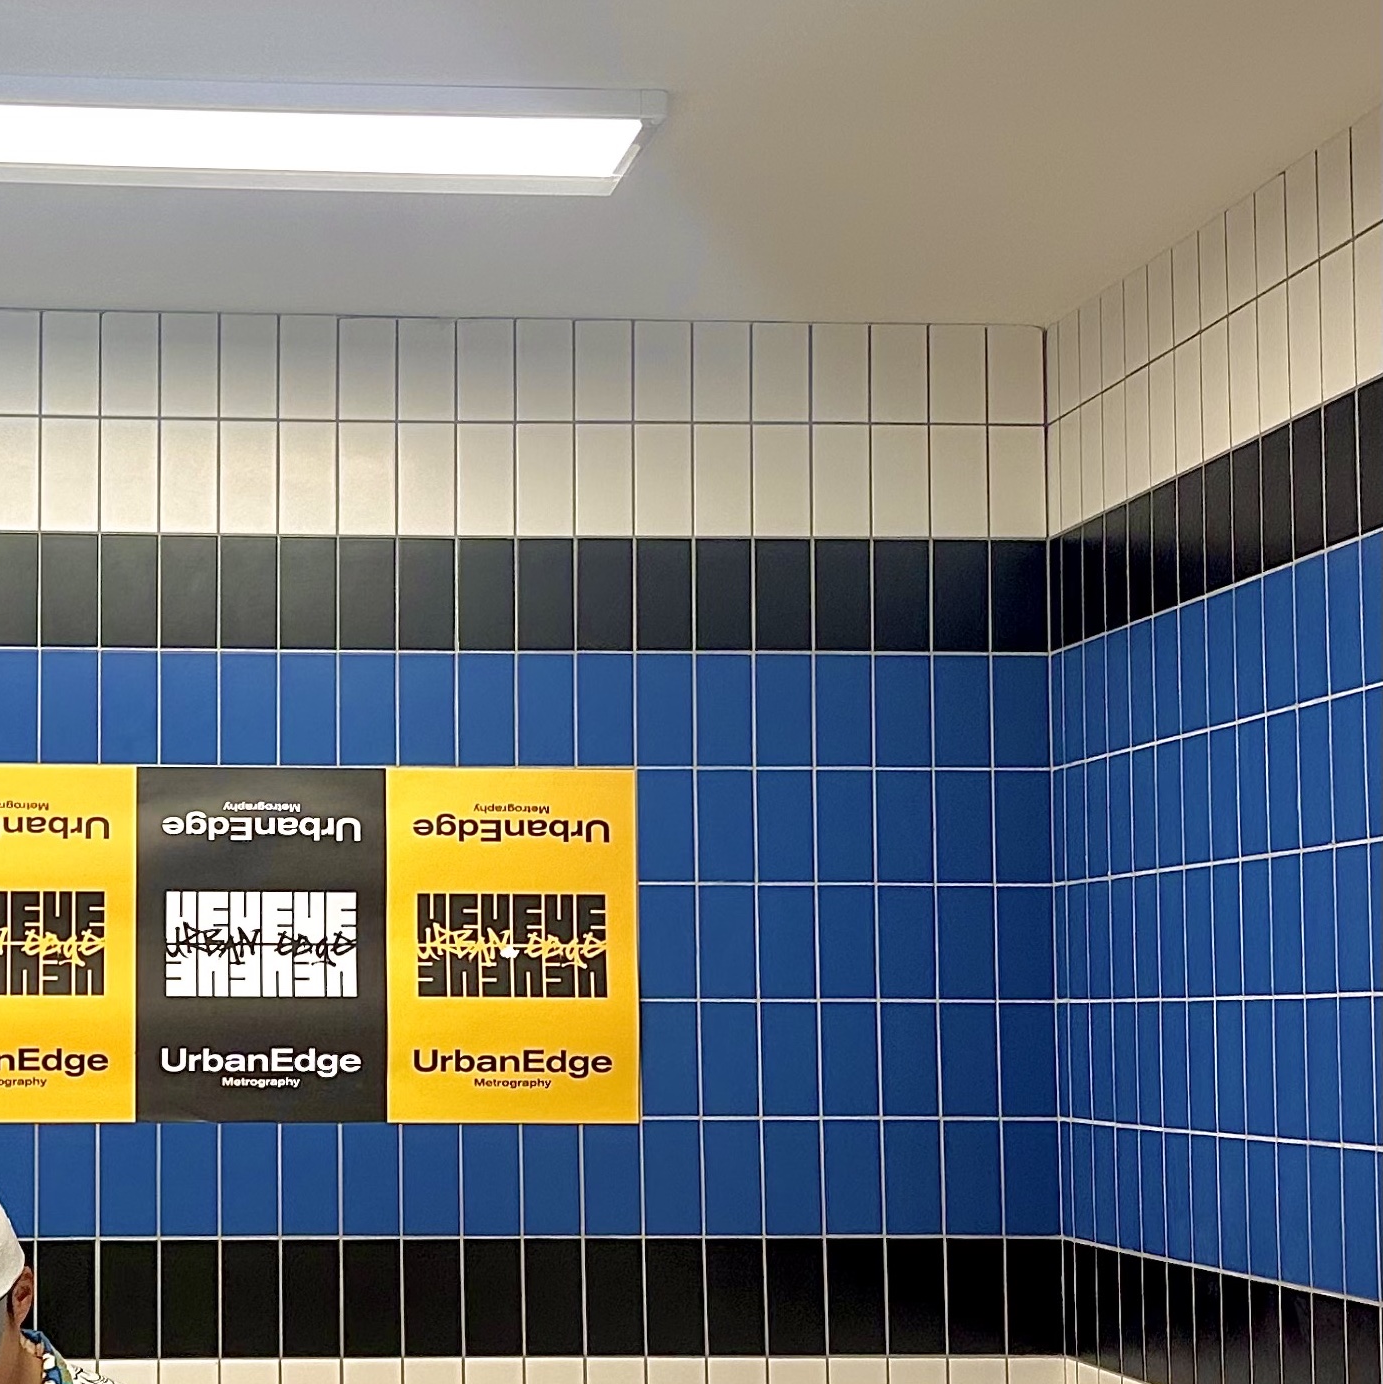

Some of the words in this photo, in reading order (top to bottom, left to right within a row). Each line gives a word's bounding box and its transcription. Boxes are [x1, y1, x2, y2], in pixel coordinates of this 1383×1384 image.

[223, 802, 301, 812] Metrography
[473, 804, 550, 813] Metrography
[162, 812, 362, 841] UrbanEdge
[413, 814, 610, 842] UrbanEdge
[162, 1048, 362, 1077] UrbanEdge
[414, 1049, 612, 1078] UrbanEdge
[222, 1077, 301, 1088] Metrography
[474, 1078, 551, 1088] Metrography
